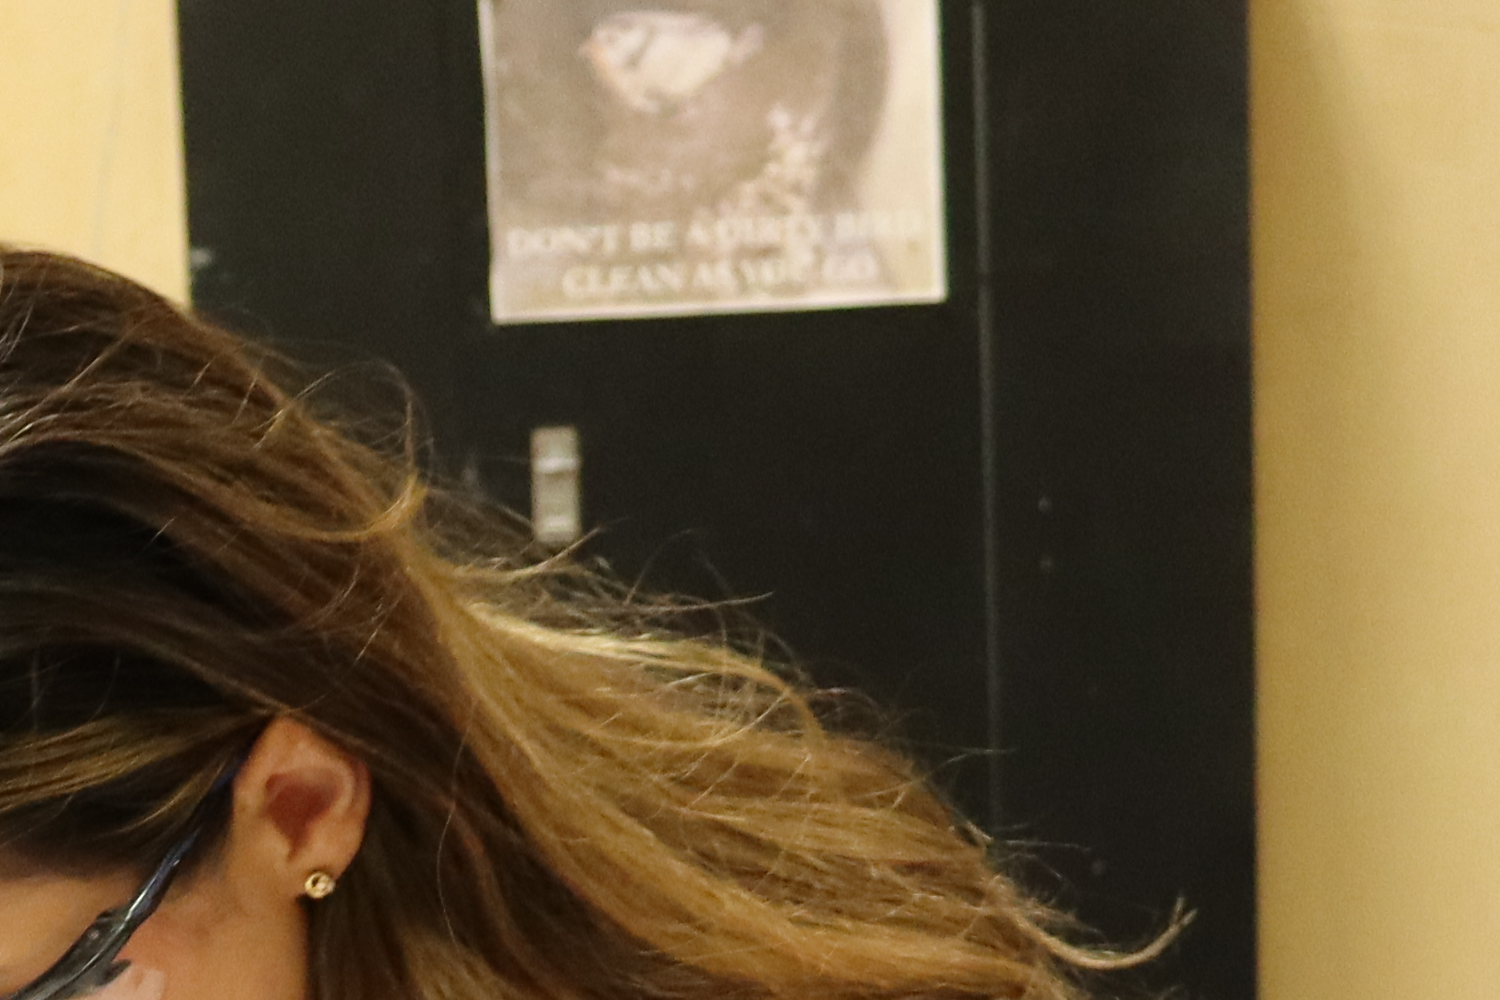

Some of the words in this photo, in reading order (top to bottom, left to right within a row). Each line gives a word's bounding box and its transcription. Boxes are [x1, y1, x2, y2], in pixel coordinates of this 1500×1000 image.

[506, 224, 619, 257] DON'T
[629, 220, 676, 252] BE
[685, 214, 713, 246] A
[561, 263, 685, 299] CLEAN
[691, 260, 734, 294] AS
[822, 252, 879, 281] GO
